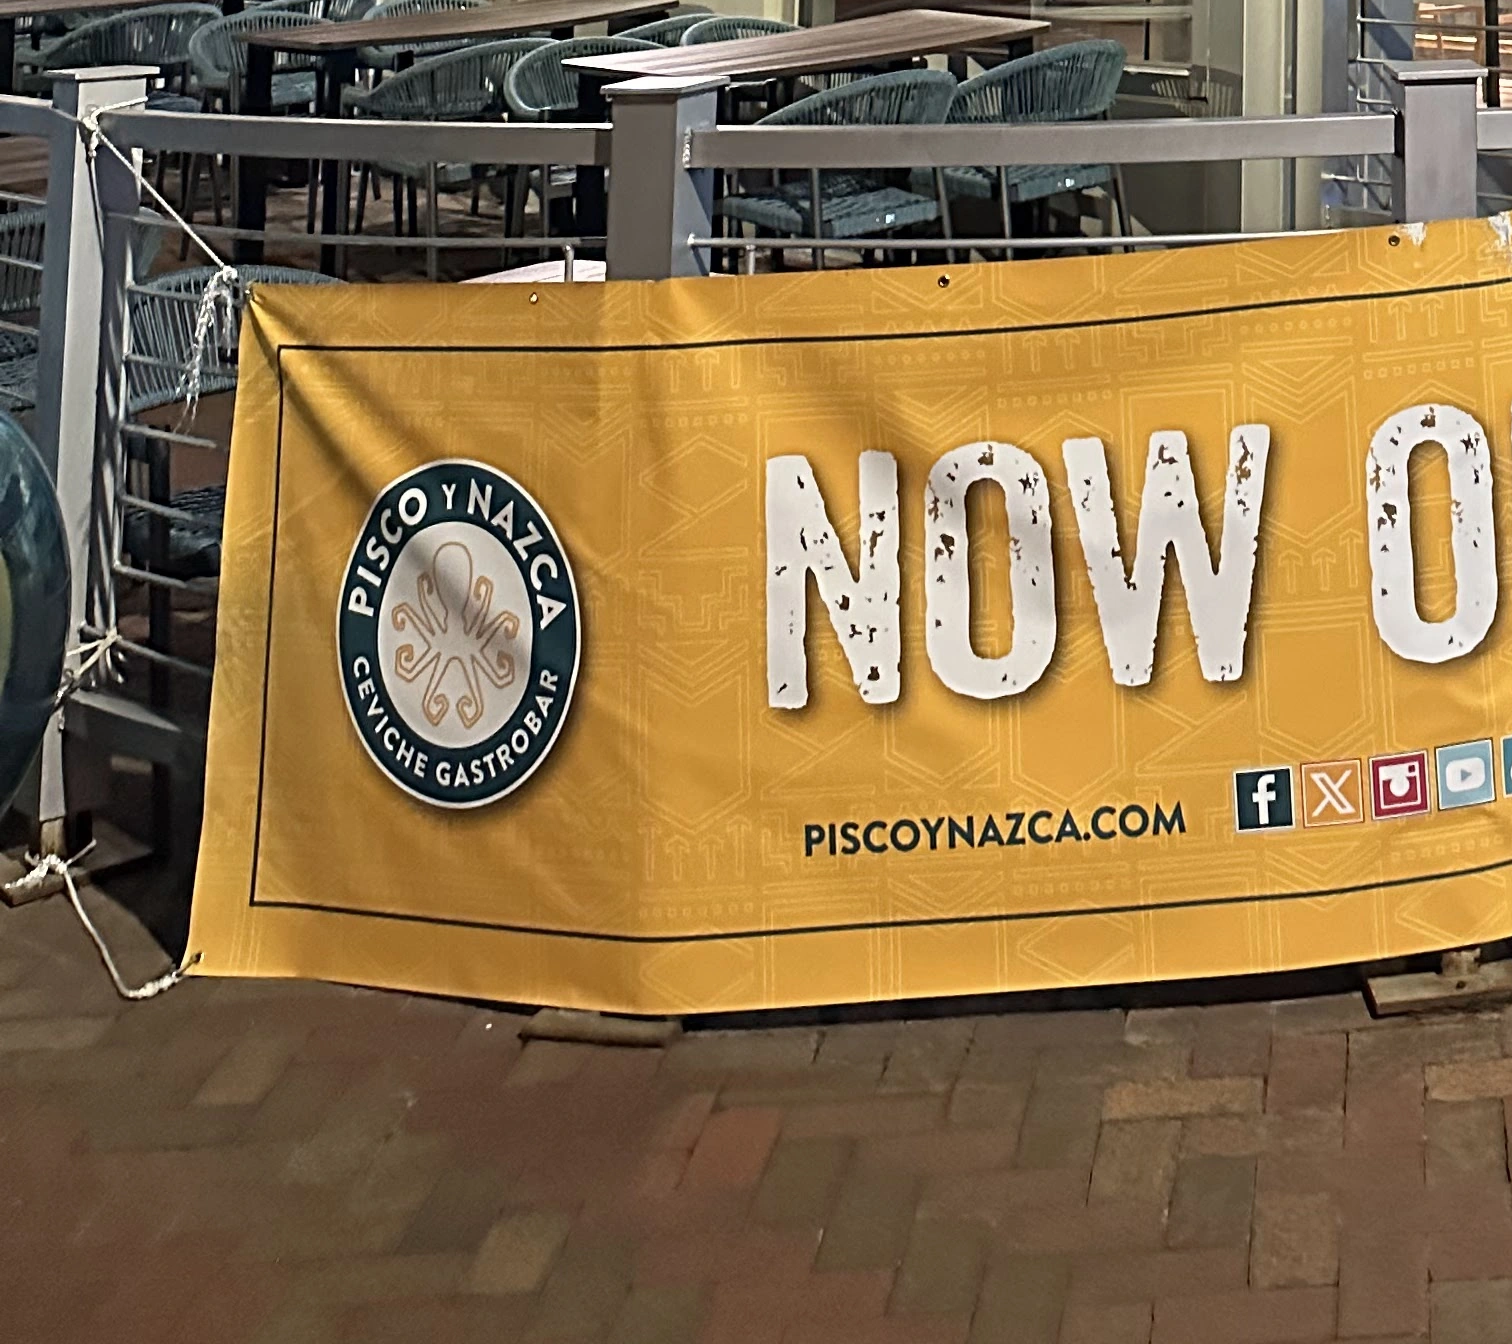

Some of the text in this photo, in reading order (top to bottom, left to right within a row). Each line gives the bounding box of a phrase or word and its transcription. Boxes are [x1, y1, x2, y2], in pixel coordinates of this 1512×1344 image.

[348, 478, 567, 631] PISCO Y NAZCA
[766, 423, 1271, 710] NOW
[353, 655, 559, 789] CEVICHE GASTROBAR
[802, 801, 1188, 857] PISCOYNAZCA.COM
